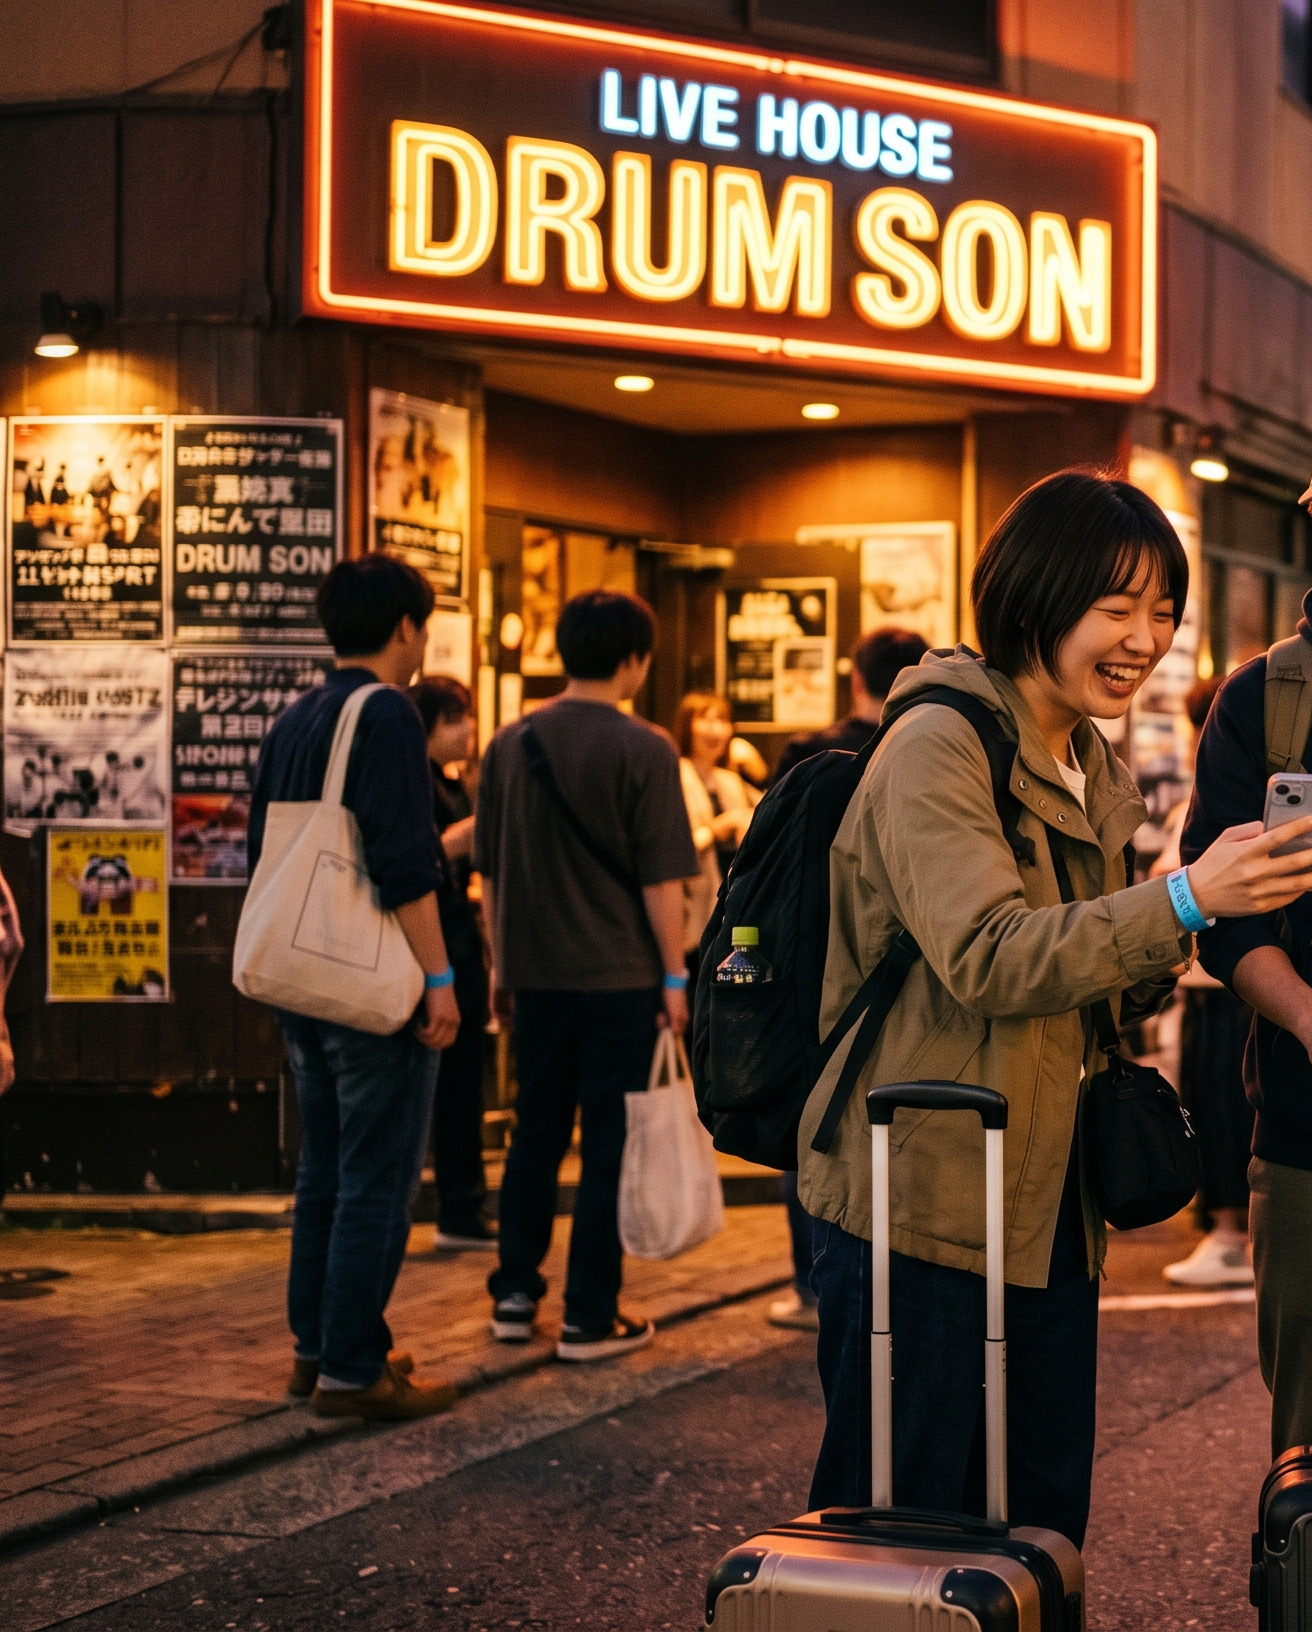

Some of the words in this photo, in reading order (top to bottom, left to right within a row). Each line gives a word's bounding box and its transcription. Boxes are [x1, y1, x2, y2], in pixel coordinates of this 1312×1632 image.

[601, 69, 739, 149] LIVE
[757, 94, 954, 183] HOUSE
[389, 119, 833, 318] DRUM
[855, 186, 1113, 353] SON
[176, 543, 262, 574] DRUM
[268, 544, 333, 575] SON
